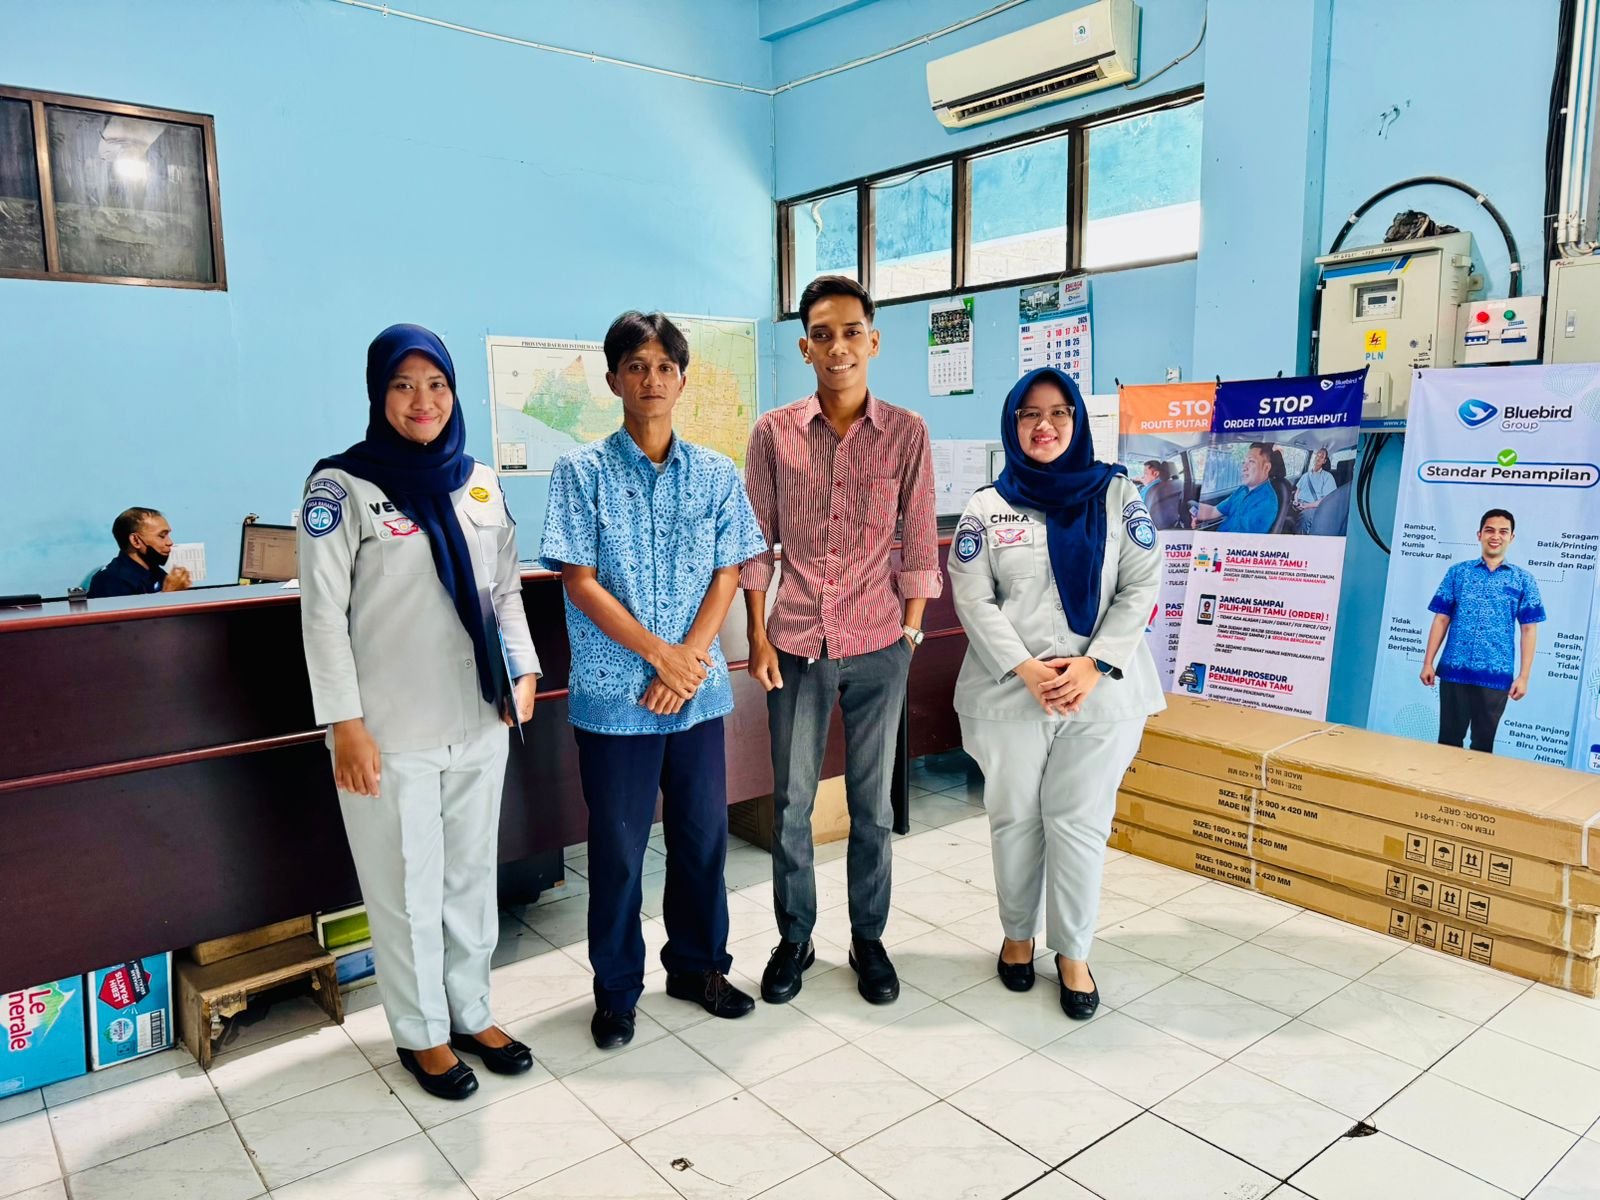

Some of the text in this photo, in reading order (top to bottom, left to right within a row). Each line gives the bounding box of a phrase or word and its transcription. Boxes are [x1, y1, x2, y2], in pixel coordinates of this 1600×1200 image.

[1365, 351, 1384, 360] PLN
[1168, 400, 1211, 417] STO
[1259, 395, 1313, 415] STOP
[1504, 405, 1572, 419] Bluebird
[1141, 418, 1209, 430] ROUTE PUTAR
[1223, 418, 1255, 429] ORDER
[1257, 416, 1284, 427] TIDAK
[1286, 413, 1342, 426] TERJEMPUT
[1502, 420, 1538, 431] Group
[1426, 465, 1591, 482] Standar Penampilan
[369, 501, 397, 515] VE
[990, 514, 1030, 523] CHIKA
[1404, 523, 1436, 532] Rambut,
[1403, 532, 1436, 541] Jenggot,
[1561, 532, 1599, 542] Seragam
[1537, 540, 1598, 551] Batik/Printing
[1227, 549, 1289, 559] JANGAN SAMPAI
[1400, 550, 1434, 558] Tercukur
[1560, 551, 1596, 562] Standar,
[1226, 557, 1251, 565] SALAH
[1528, 559, 1555, 569] Bersih
[1576, 563, 1595, 571] Rapi
[1220, 596, 1284, 608] JANGAN SAMPAI
[1219, 603, 1261, 614] PILIH-PILIH
[1263, 607, 1287, 616] TAMU
[1289, 609, 1324, 621] (ORDER)
[1391, 617, 1411, 625] Tidak
[1390, 626, 1422, 635] Memakai
[1557, 632, 1584, 641] Badan
[1389, 635, 1422, 644] Aksesoris
[1388, 644, 1425, 654] Berlebihan
[1554, 642, 1583, 652] Bersih,
[1555, 652, 1581, 662] Segar,
[1557, 662, 1579, 671] Tidak
[1210, 665, 1288, 683] PAHAMI PROSEDUR
[1547, 670, 1578, 681] Berbau
[1209, 672, 1293, 692] PENJEMPUTAN TAMU
[1504, 720, 1570, 737] Celana Panjang
[1509, 730, 1568, 746] Bahan, Warna
[1516, 741, 1567, 756] Biru Donker
[1534, 752, 1565, 766] /Hitam,
[1284, 771, 1302, 780] MADE
[1218, 788, 1238, 800] SIZE:
[1265, 800, 1279, 810] 900
[1287, 804, 1301, 815] 420
[1304, 809, 1318, 820] MM
[1218, 799, 1240, 810] MADE
[1241, 804, 1250, 812] IN
[1438, 805, 1495, 824] COLOR: GREY
[1193, 819, 1211, 829] SIZE:
[1213, 824, 1230, 834] 1800
[1258, 835, 1272, 847] 420
[1274, 840, 1288, 851] MM
[1475, 826, 1495, 836] ITEM
[1192, 828, 1248, 850] MADE IN CHINA
[1195, 863, 1251, 885] MADE IN CHINA
[1196, 852, 1214, 863] SIZE:
[1215, 858, 1232, 868] 1800
[1261, 870, 1275, 881] 420
[1277, 875, 1291, 887] MM
[109, 979, 122, 1002] LEBIH
[115, 971, 130, 1004] PRAKTIS
[29, 990, 52, 1014] Le
[8, 992, 32, 1050] nerale
